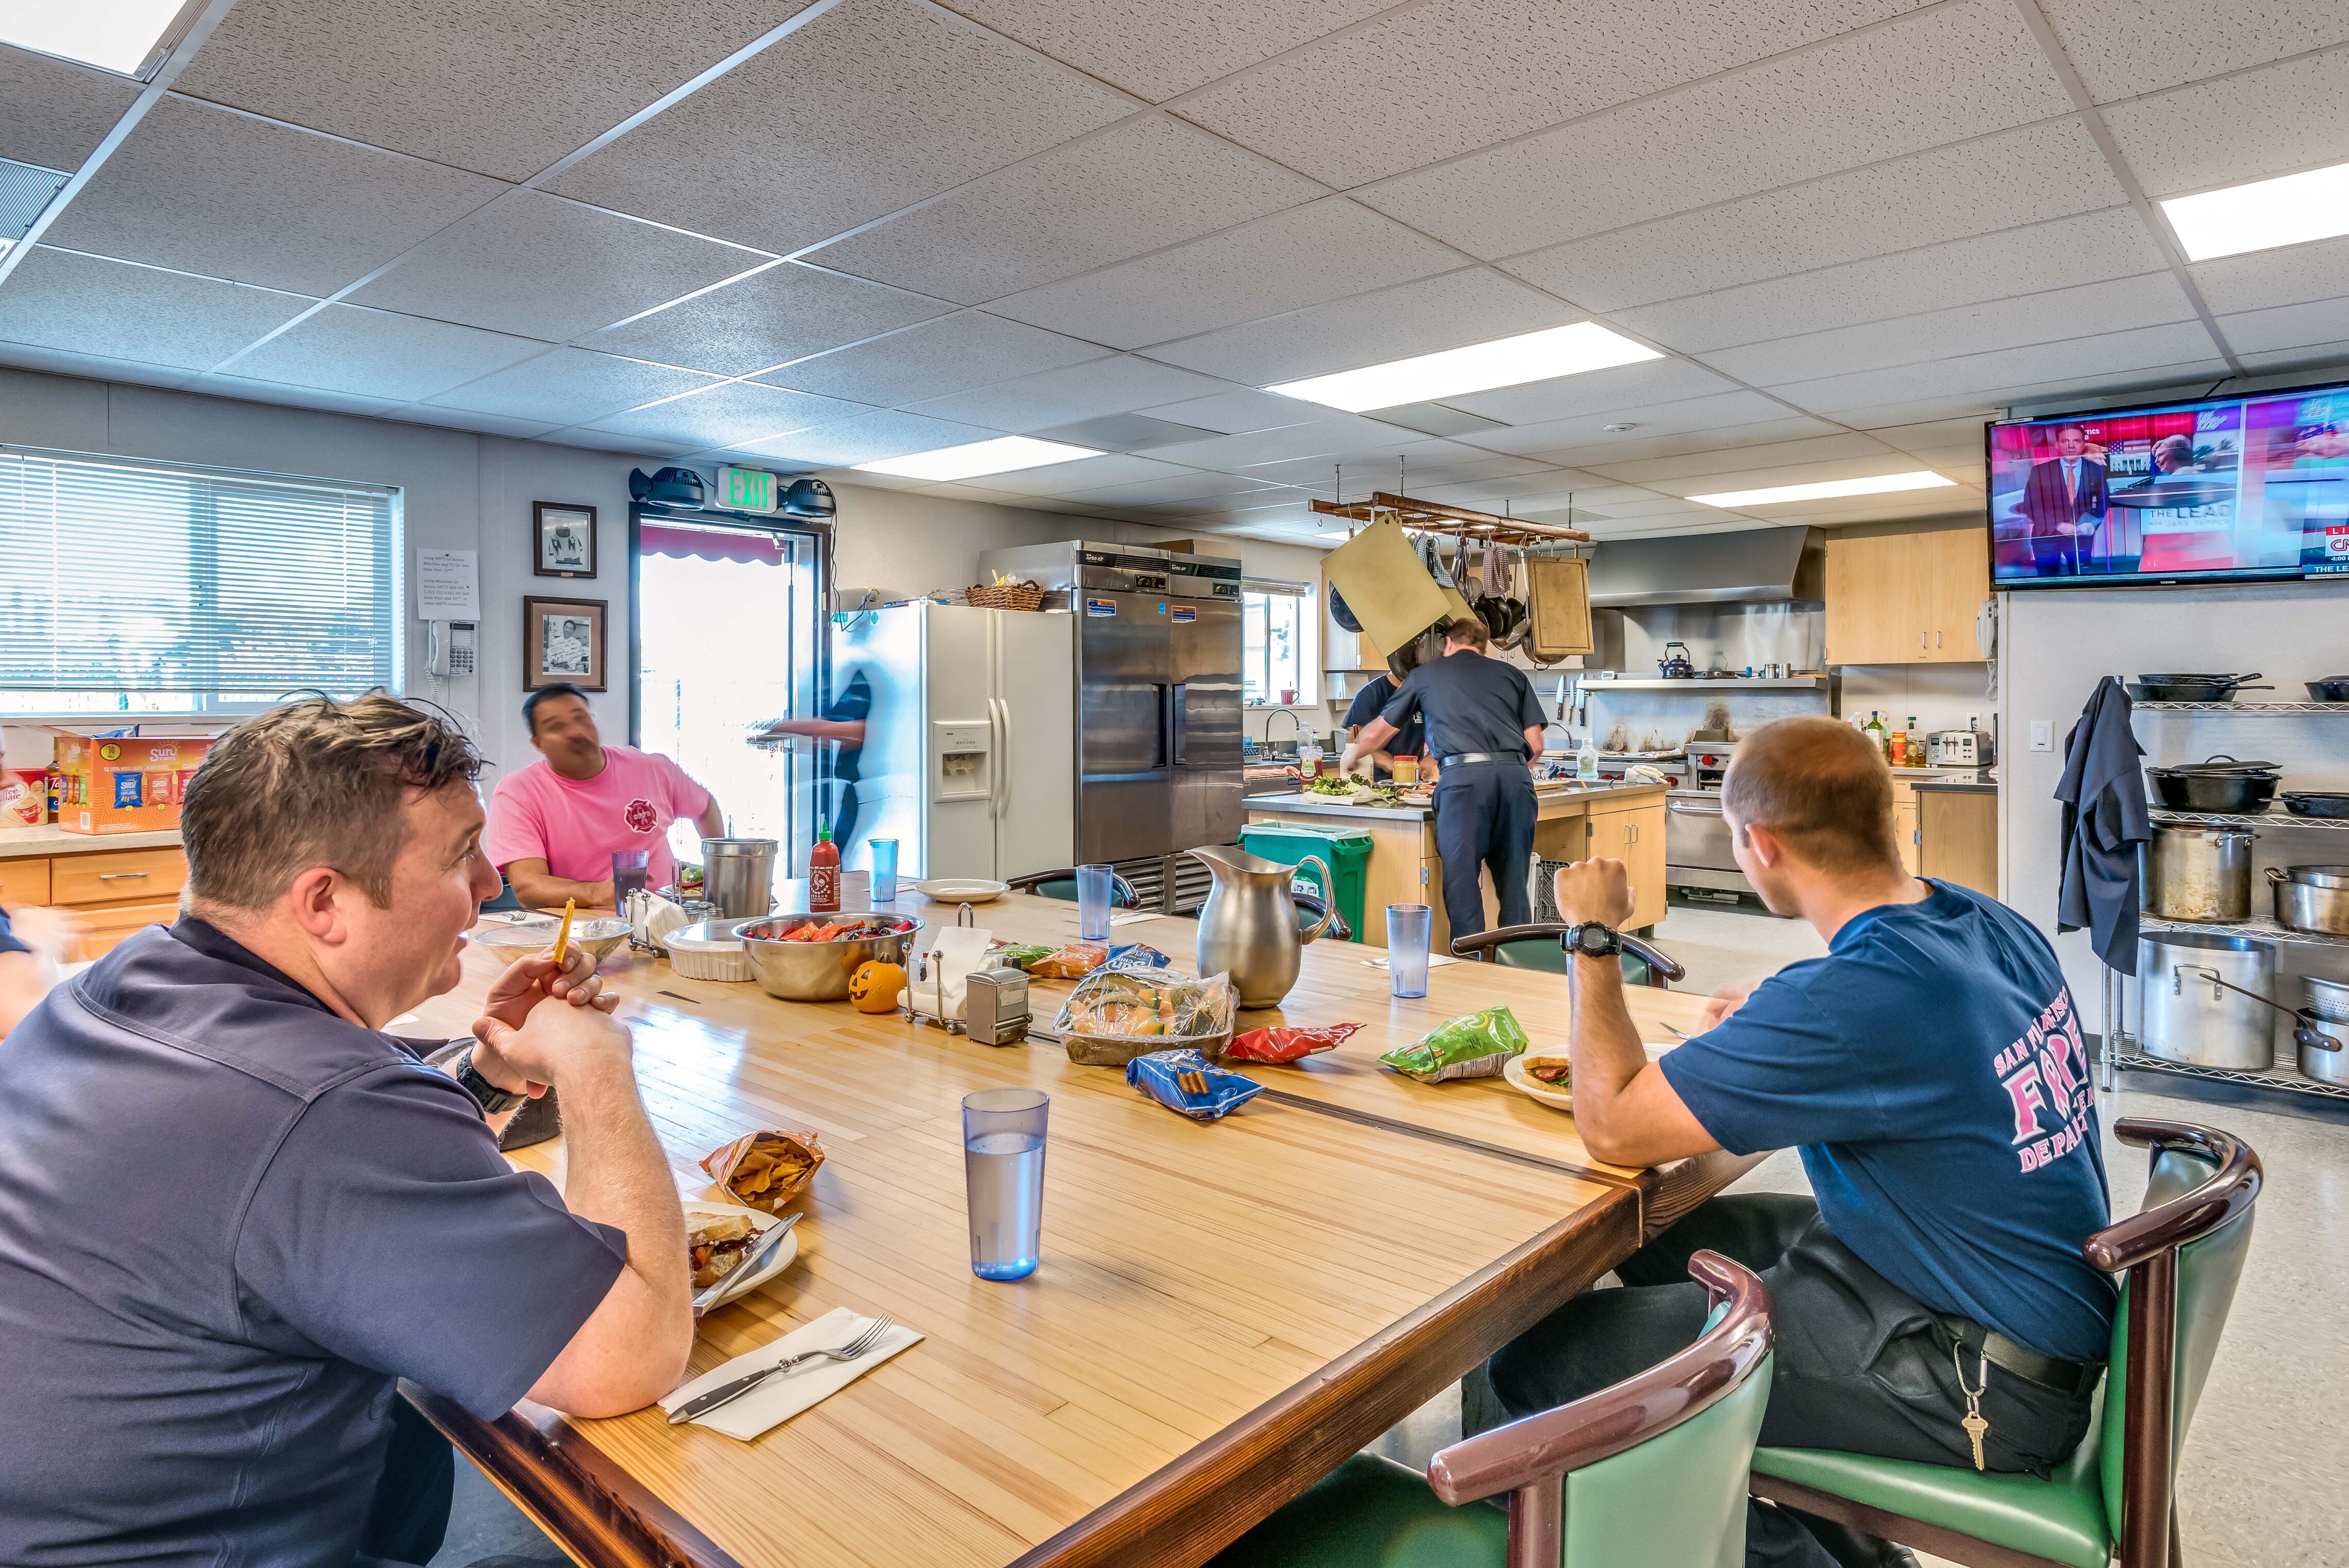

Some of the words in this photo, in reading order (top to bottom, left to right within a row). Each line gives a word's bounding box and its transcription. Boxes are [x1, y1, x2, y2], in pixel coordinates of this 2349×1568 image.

[729, 470, 770, 507] EXIT
[2177, 505, 2231, 518] LEAD
[2330, 538, 2349, 551] CN
[107, 745, 115, 755] 30
[149, 748, 176, 762] Sun
[121, 781, 136, 790] Sun
[1994, 1037, 2030, 1079] SAN
